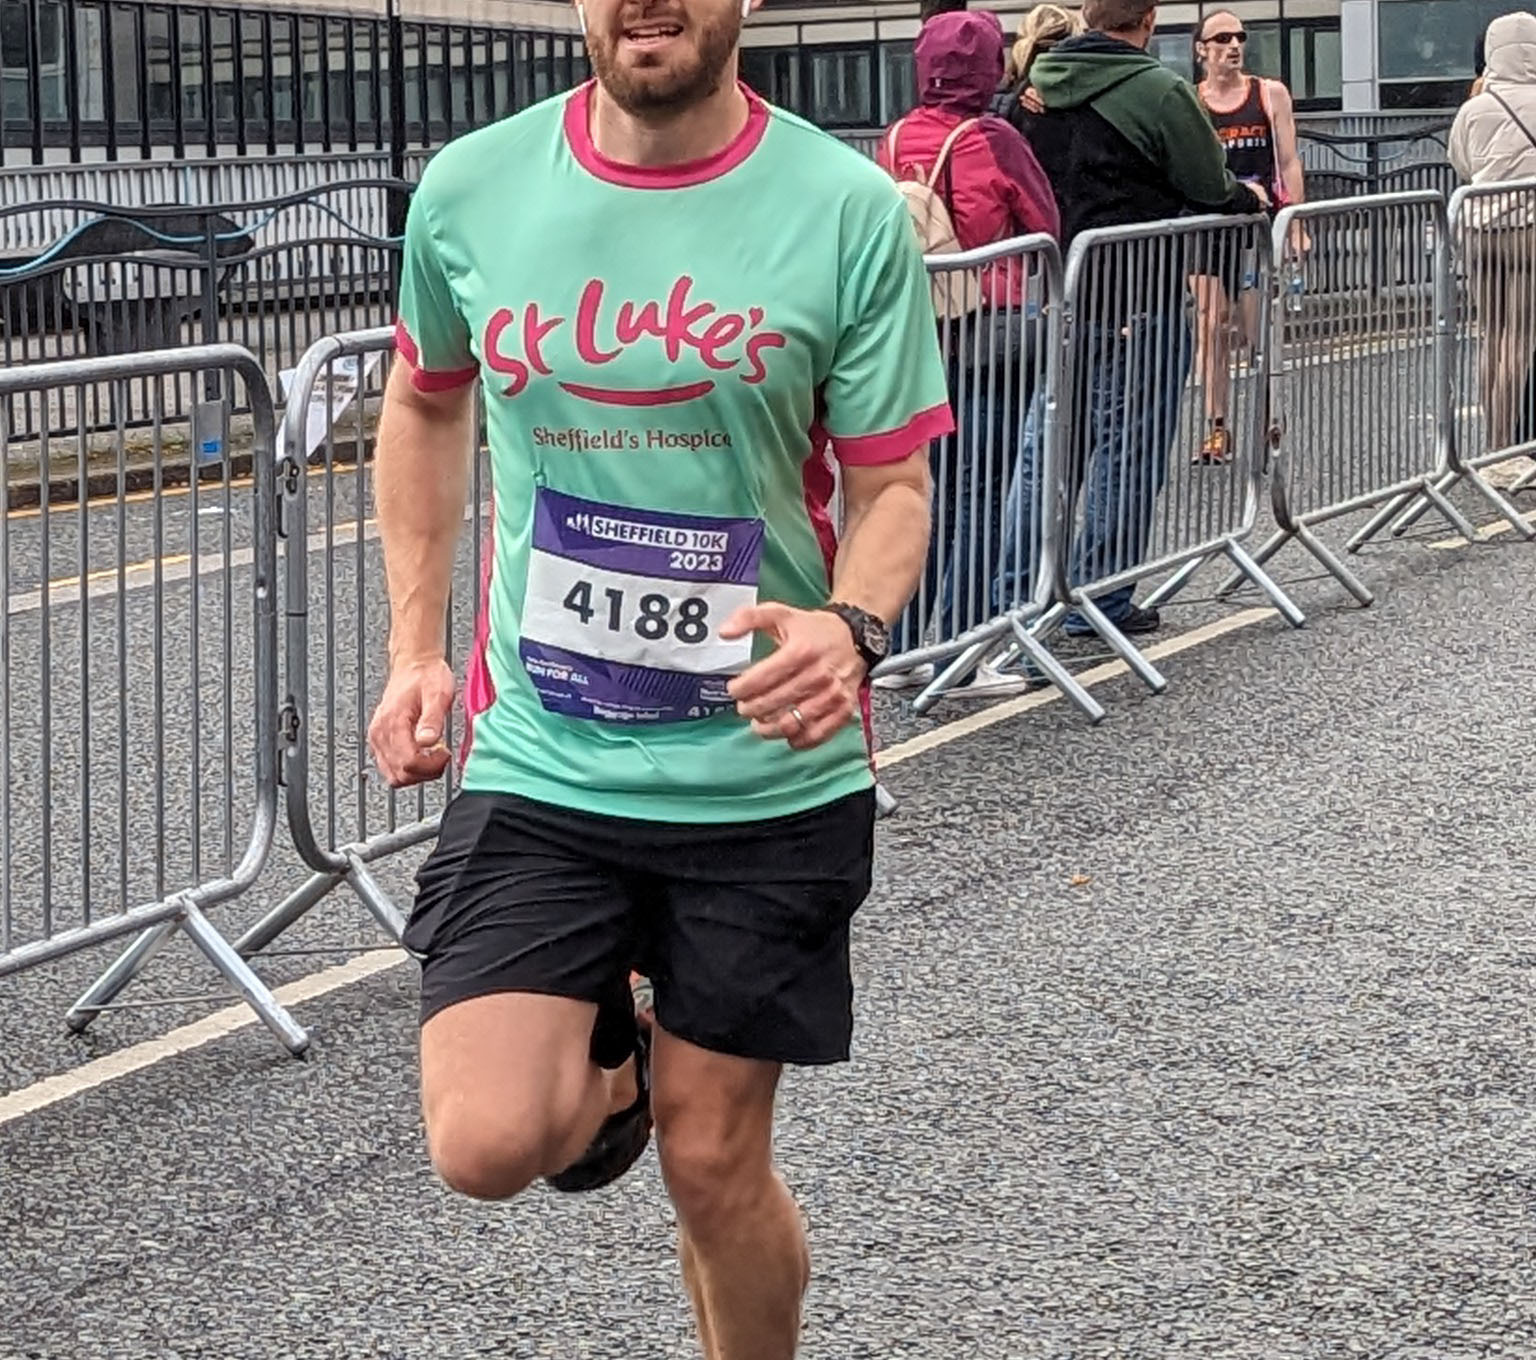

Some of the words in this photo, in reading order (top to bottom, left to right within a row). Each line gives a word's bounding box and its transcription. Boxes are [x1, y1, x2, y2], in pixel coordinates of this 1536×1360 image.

[576, 275, 787, 385] Luke's
[533, 426, 639, 452] Sheffield's
[646, 429, 731, 451] Hospice
[594, 518, 688, 547] SHEFFIELD
[692, 533, 725, 550] 10K
[669, 551, 724, 571] 2023
[563, 580, 709, 644] 4188
[546, 668, 569, 681] FOR
